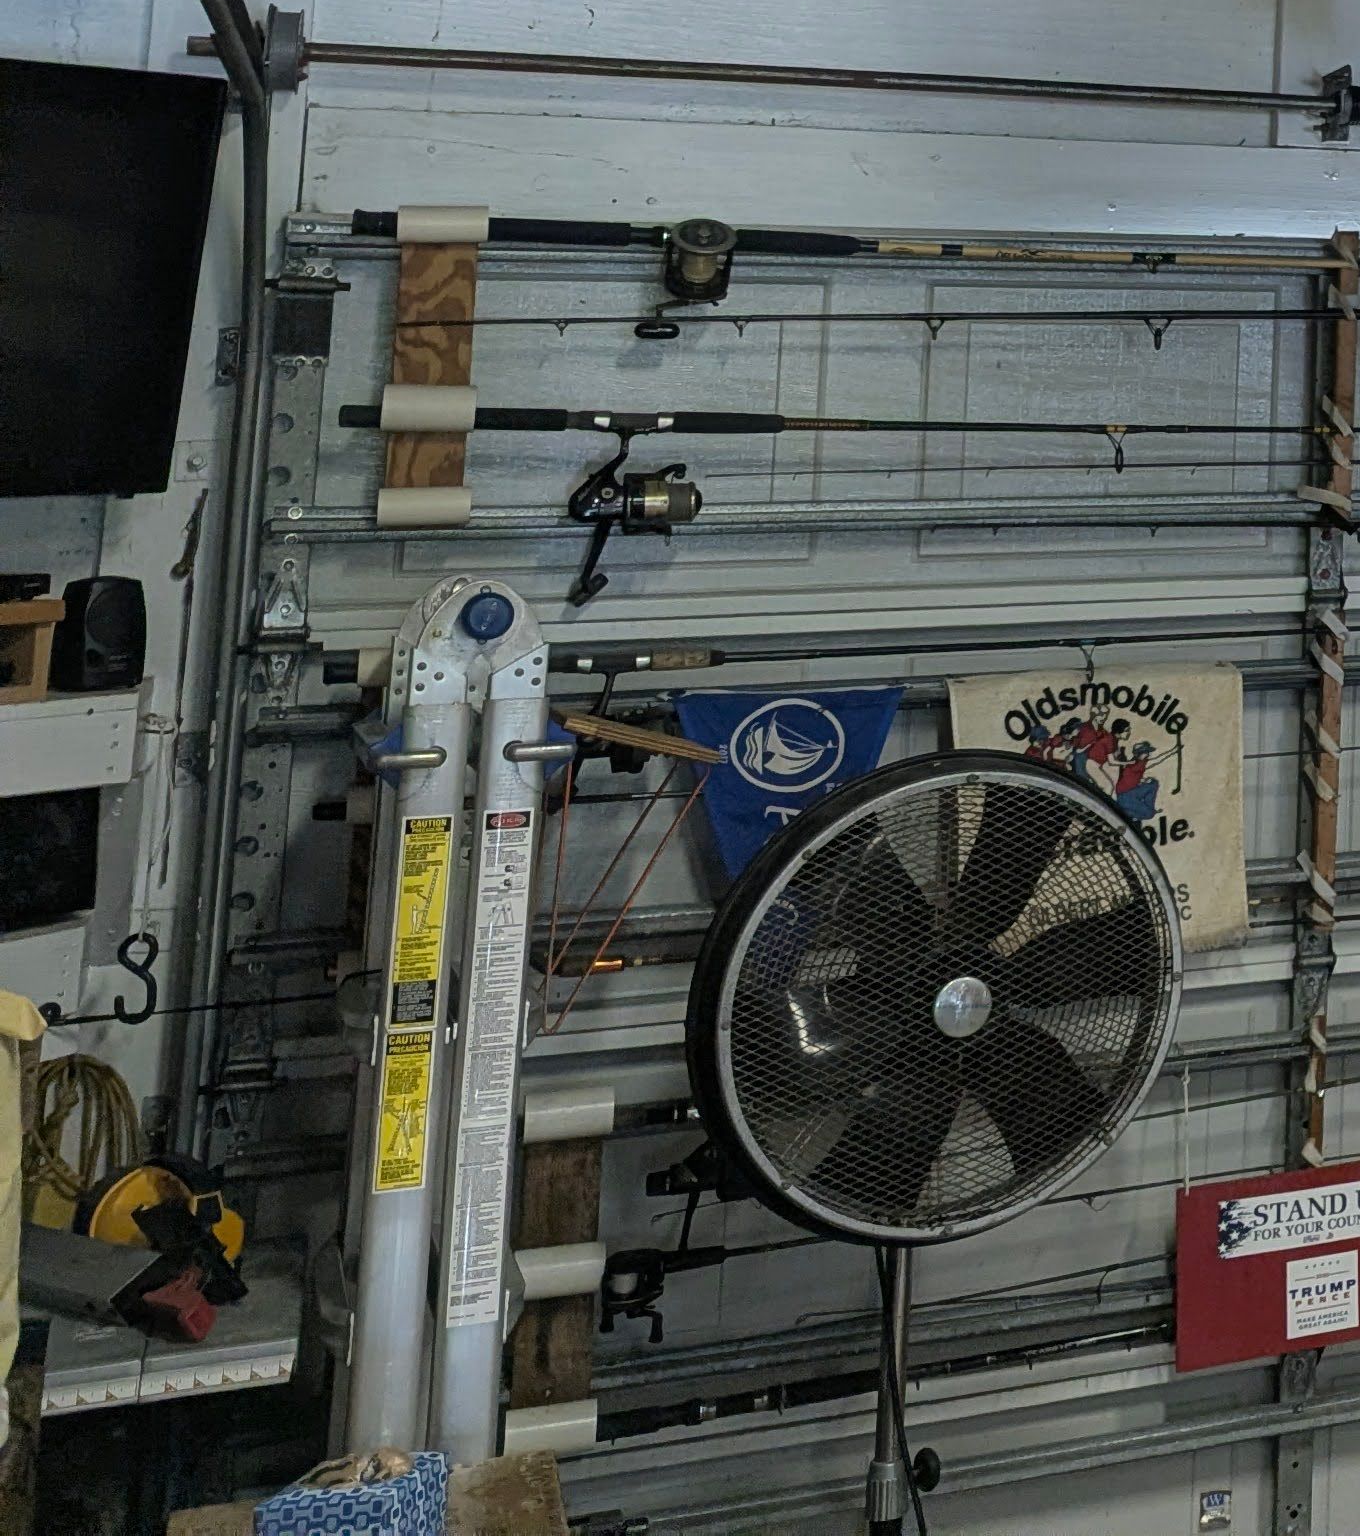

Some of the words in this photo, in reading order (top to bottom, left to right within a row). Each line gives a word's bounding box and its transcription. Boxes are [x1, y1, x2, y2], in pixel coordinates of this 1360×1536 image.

[1003, 681, 1188, 742] Oldsmobile
[388, 1032, 431, 1046] CAUTION
[1253, 1191, 1348, 1228] STAND
[1253, 1225, 1282, 1242] FOR
[1285, 1219, 1324, 1237] YOUR
[1288, 1279, 1357, 1300] TRUMP
[1295, 1291, 1351, 1307] PENCE
[1297, 1315, 1317, 1324] MAKE
[1318, 1310, 1349, 1320] AMERICA
[1298, 1321, 1322, 1331] GREAT
